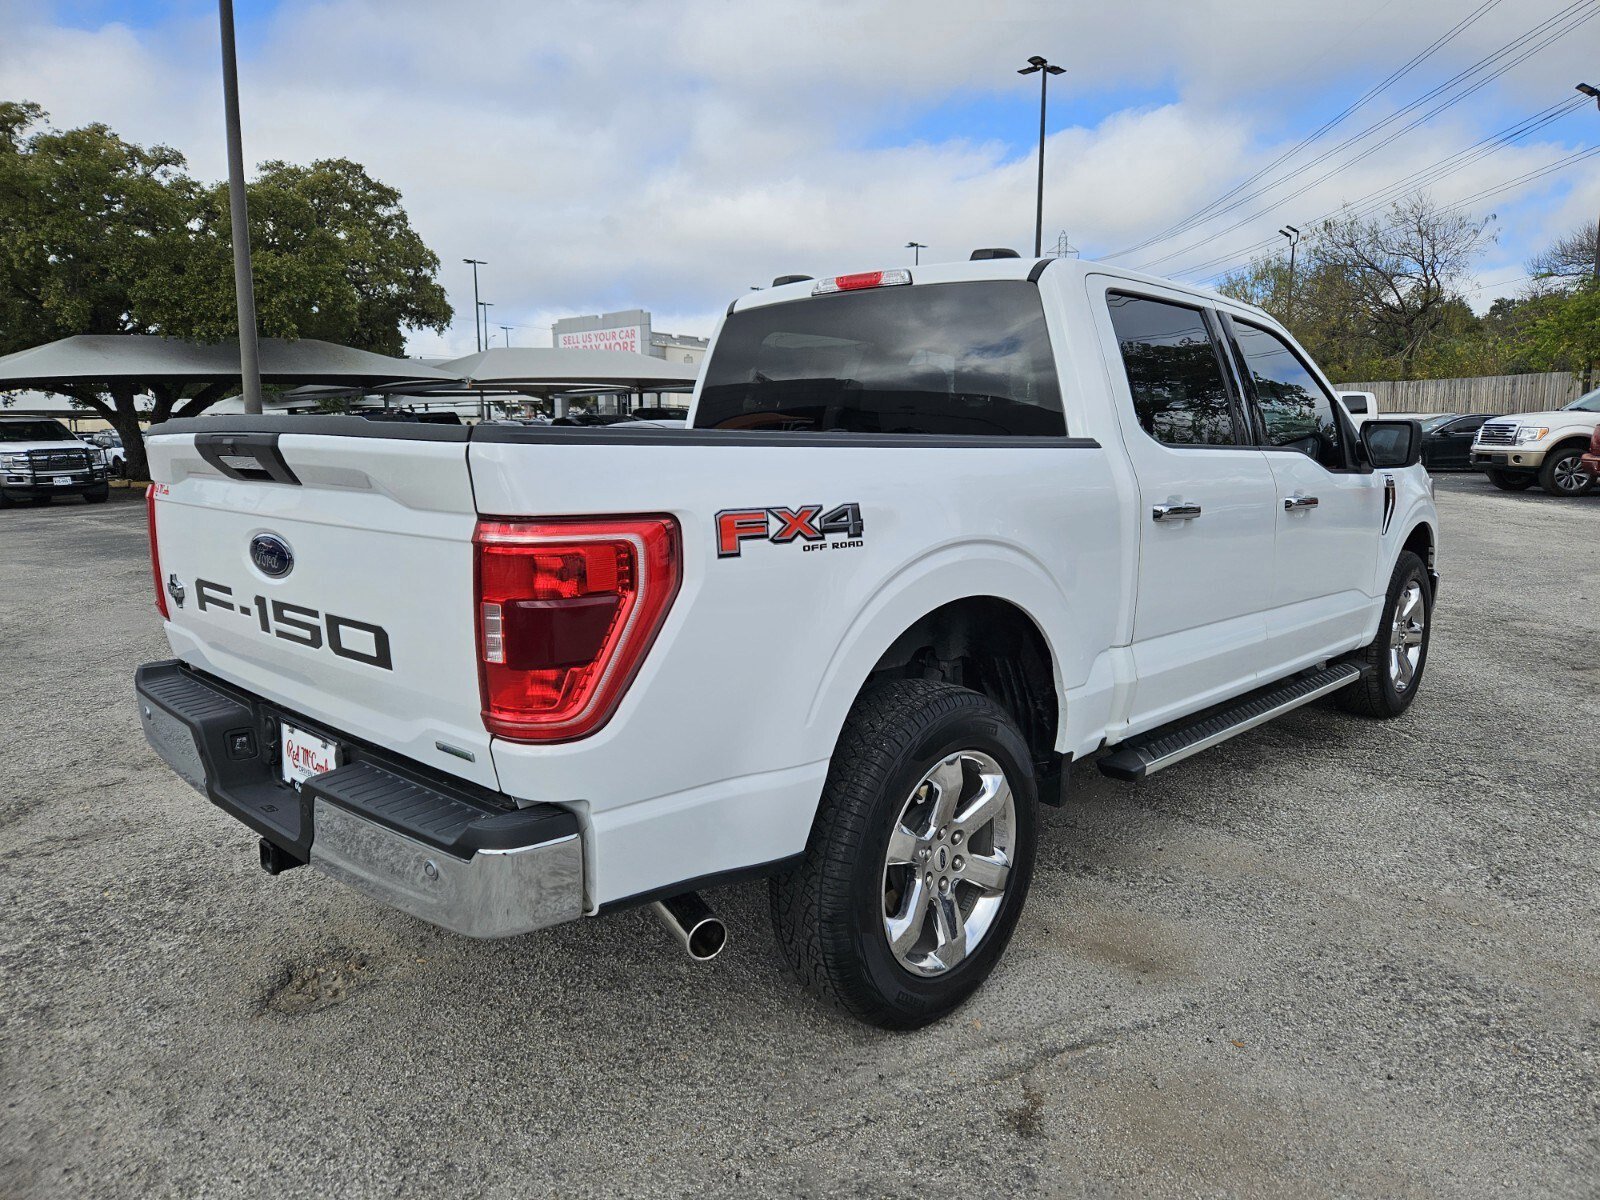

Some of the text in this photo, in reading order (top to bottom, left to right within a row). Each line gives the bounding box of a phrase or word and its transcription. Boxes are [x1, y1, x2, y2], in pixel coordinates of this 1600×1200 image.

[562, 329, 636, 346] SELL US YOUR CAR
[604, 341, 636, 353] MORE
[714, 502, 864, 559] FX4
[254, 541, 279, 569] Ford
[803, 540, 864, 552] OFF ROAD
[194, 577, 394, 671] F-150
[287, 740, 329, 772] Red McComb
